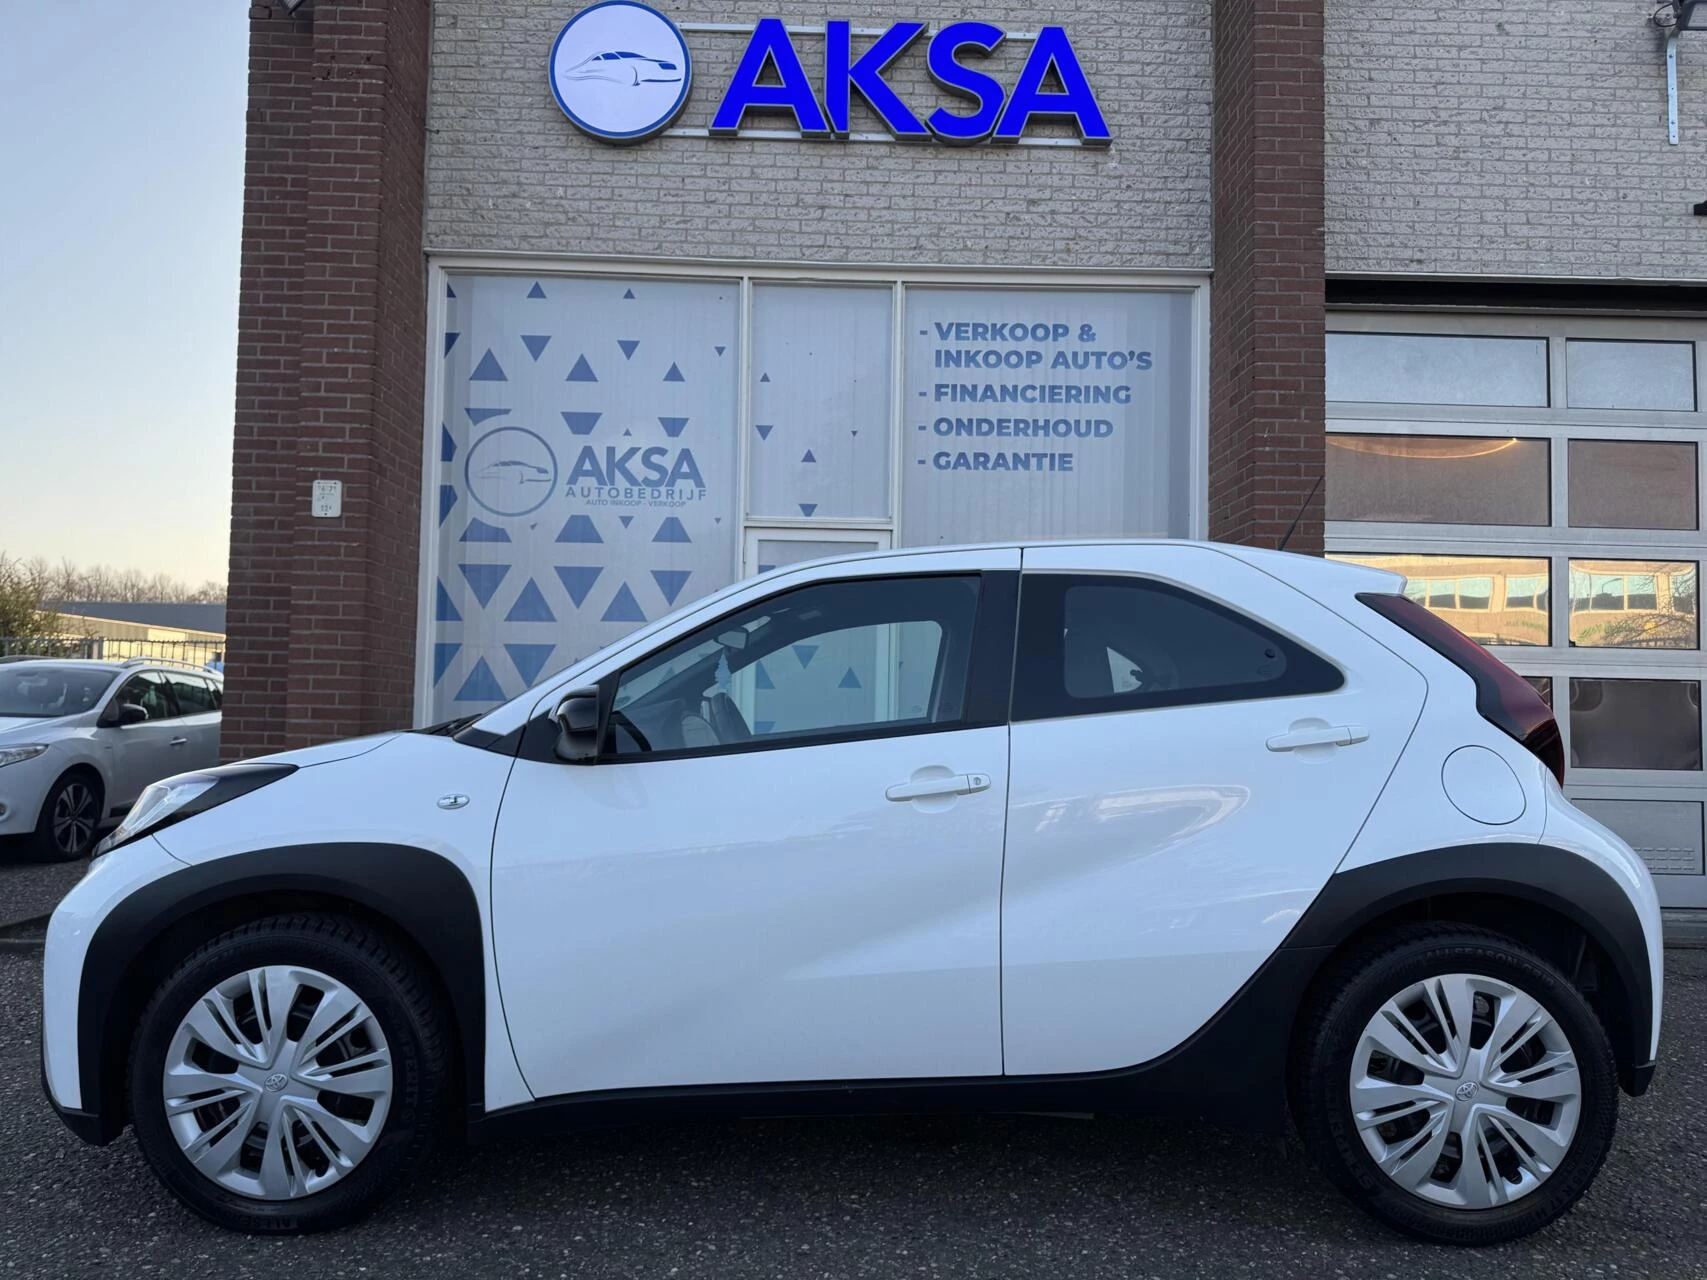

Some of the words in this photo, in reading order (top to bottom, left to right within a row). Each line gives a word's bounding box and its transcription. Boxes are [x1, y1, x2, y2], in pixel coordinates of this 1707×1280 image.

[710, 18, 1111, 142] AKSA
[933, 321, 1070, 343] VERKOOP
[1077, 323, 1097, 343] &
[934, 349, 1043, 369] INKOOP
[934, 383, 1132, 405] FINANCIERING
[932, 416, 1114, 438] ONDERHOUD
[565, 445, 707, 488] AKSA
[932, 450, 1074, 472] GARANTIE
[565, 487, 707, 501] AUTOBEDRIJF
[610, 499, 642, 507] INKOOP
